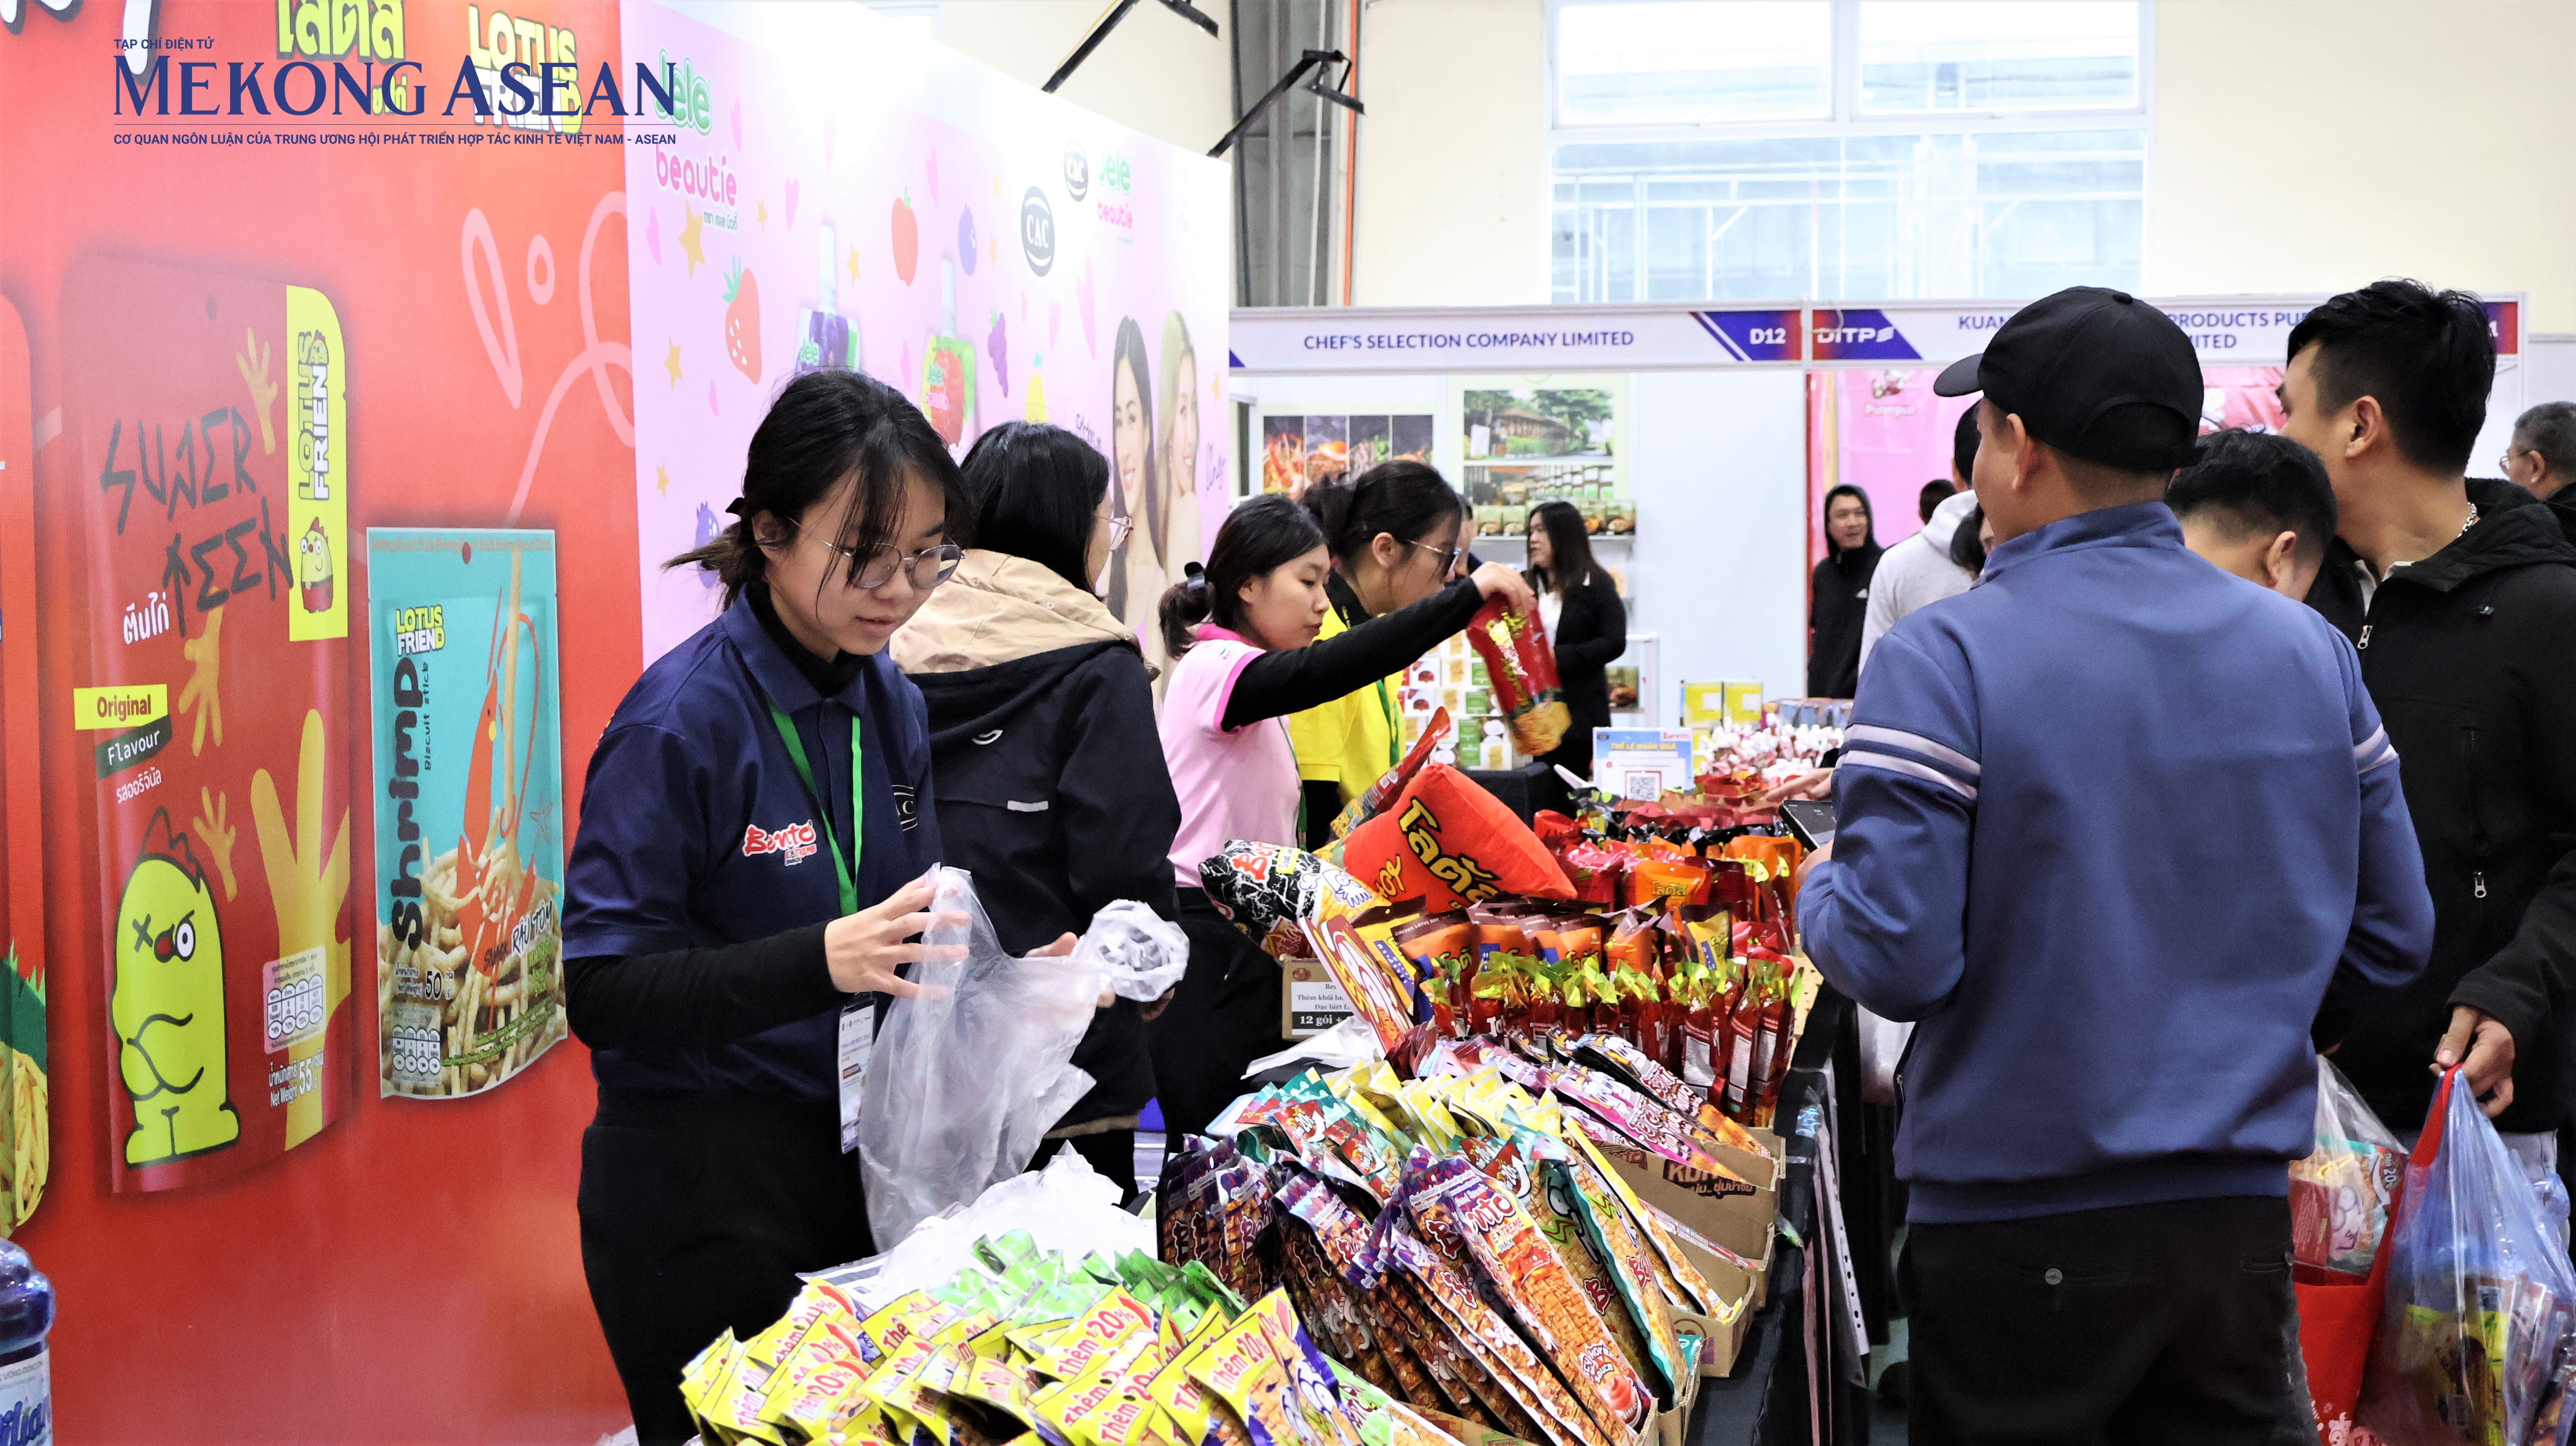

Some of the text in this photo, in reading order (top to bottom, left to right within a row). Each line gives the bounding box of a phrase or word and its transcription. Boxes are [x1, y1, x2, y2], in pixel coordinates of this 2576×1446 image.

[468, 4, 579, 80] LOTUS
[1027, 214, 1049, 248] CAC
[1304, 331, 1634, 349] CHEF'S SELECTION COMPANY LIMITED
[1750, 328, 1786, 345] D12
[298, 331, 312, 500] LOTUS
[395, 605, 443, 633] LOTUS
[397, 627, 445, 656] FRIEND
[97, 694, 151, 722] Original
[108, 729, 160, 766] Flavour
[745, 825, 814, 854] Bento
[426, 970, 442, 999] 50
[1300, 1016, 1313, 1024] 12
[1316, 1015, 1333, 1027] gói
[299, 1057, 313, 1095] 55
[270, 1091, 280, 1108] Net
[1491, 1218, 1524, 1244] EXTREME
[1498, 1238, 1514, 1252] SNACK
[1058, 1339, 1100, 1377] Thêm
[1086, 1309, 1135, 1340] 20%
[1212, 1332, 1272, 1390] Thêm 20%
[806, 1368, 854, 1396] 20%
[1101, 1403, 1140, 1444] Thêm
